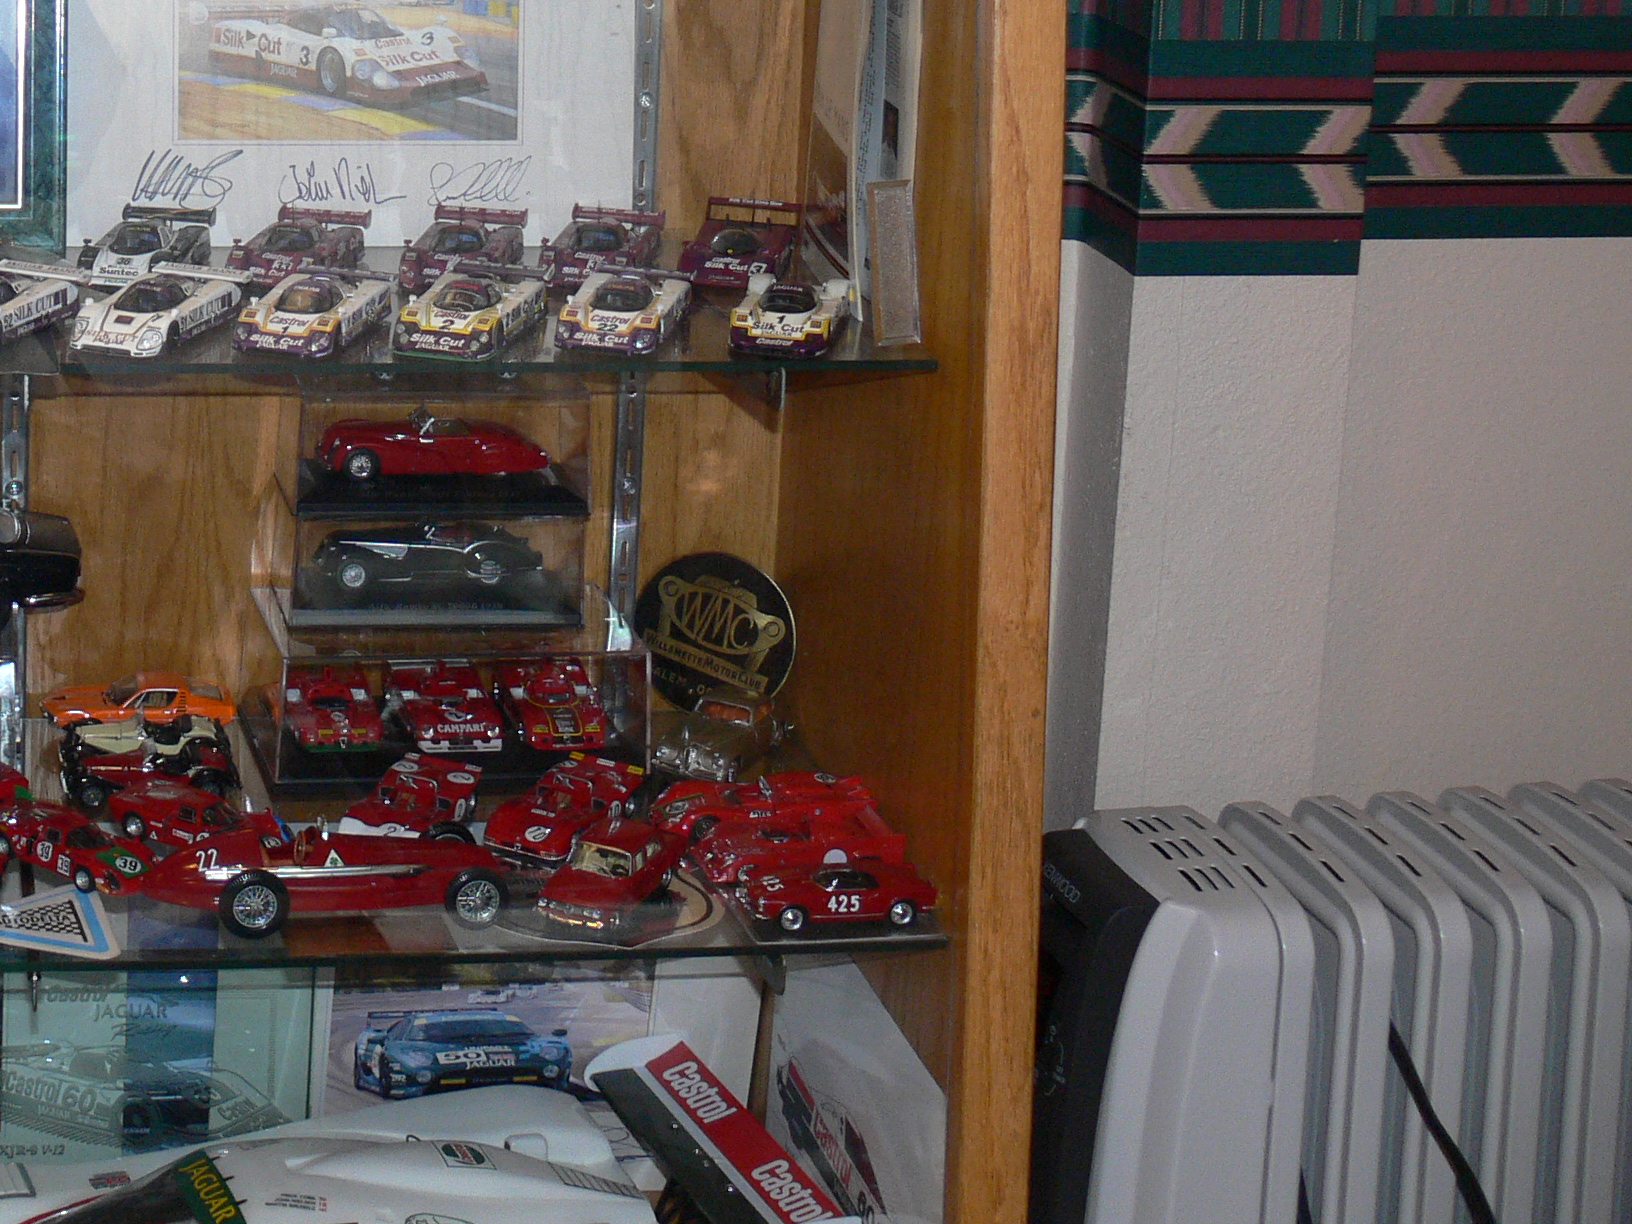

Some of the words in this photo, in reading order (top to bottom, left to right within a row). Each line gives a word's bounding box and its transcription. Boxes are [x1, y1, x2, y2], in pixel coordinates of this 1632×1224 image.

[421, 31, 435, 47] 3
[221, 28, 245, 51] Silk
[257, 32, 282, 56] Cut
[299, 45, 310, 66] 3
[378, 52, 411, 67] Silk
[410, 49, 440, 64] Cut
[98, 266, 140, 277] Suntec
[771, 285, 804, 293] JAGUAR
[3, 315, 14, 330] 52
[13, 305, 33, 324] SILK
[34, 295, 53, 313] CUT
[590, 314, 631, 325] Castrol
[776, 314, 786, 324] 1
[269, 314, 311, 327] Castrol
[441, 319, 456, 331] 2
[752, 321, 777, 331] Silk
[777, 323, 805, 334] Cut
[249, 333, 279, 344] Silk
[279, 336, 306, 347] Cut
[409, 333, 441, 344] Silk
[440, 336, 466, 348] Cut
[573, 332, 605, 343] Silk
[605, 334, 630, 345] Cut
[755, 337, 794, 347] Castrol
[681, 591, 757, 650] WMC
[437, 722, 486, 734] CAMPARI
[37, 842, 52, 860] 39
[58, 856, 71, 875] 39
[117, 857, 139, 872] 39
[195, 849, 218, 871] 22
[827, 894, 861, 913] 425
[93, 1003, 168, 1021] JAGUAR
[439, 1050, 483, 1064] 50
[465, 1057, 517, 1071] JAGUAR
[6, 1072, 62, 1106] Castrol
[65, 1083, 95, 1115] 60
[662, 1059, 739, 1124] Castrol
[180, 1159, 236, 1224] JAGUAR
[751, 1158, 836, 1224] Castrol
